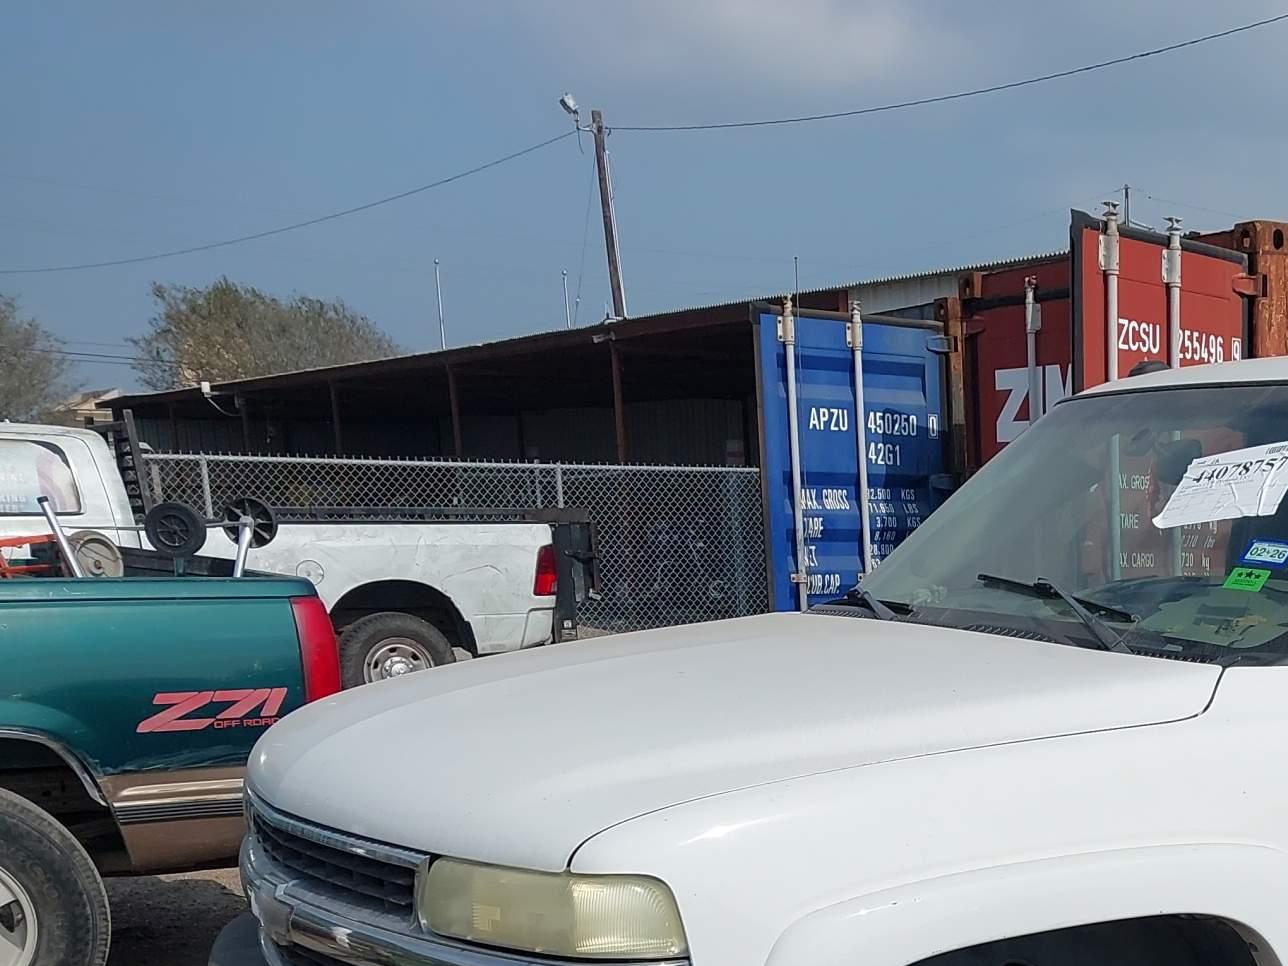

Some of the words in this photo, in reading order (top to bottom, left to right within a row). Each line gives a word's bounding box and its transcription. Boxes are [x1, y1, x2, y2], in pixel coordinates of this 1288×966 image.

[1118, 318, 1160, 354] ZCSU
[809, 407, 848, 431] APZU
[867, 411, 917, 436] 450250
[868, 442, 900, 466] 42G1
[822, 488, 850, 510] GROSS
[901, 488, 915, 500] KGS
[1120, 513, 1139, 529] TARE
[1131, 553, 1155, 568] CARGO
[136, 687, 289, 733] Z71
[213, 718, 241, 729] OFF
